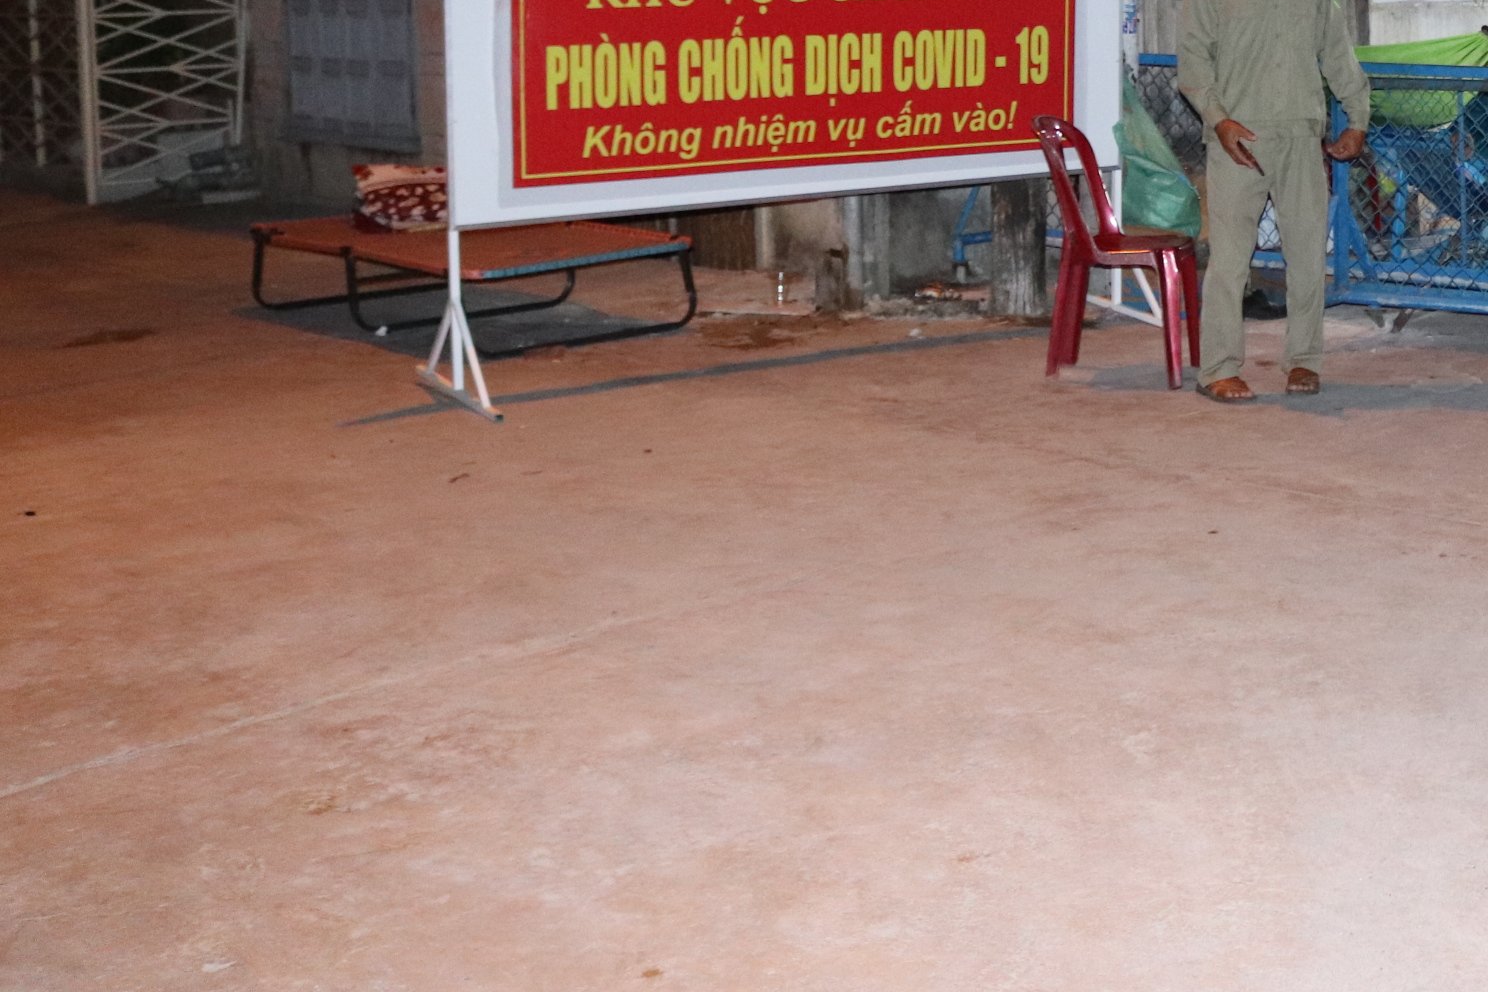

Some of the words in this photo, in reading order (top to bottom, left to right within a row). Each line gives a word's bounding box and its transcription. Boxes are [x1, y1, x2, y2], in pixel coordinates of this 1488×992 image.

[545, 32, 667, 111] PHÒNG
[677, 15, 794, 104] CHỐNG
[804, 32, 883, 106] DỊCH
[892, 28, 986, 92] COVID
[994, 55, 1007, 68] -
[1015, 25, 1050, 85] 19
[582, 122, 702, 160] Không
[712, 113, 817, 156] nhiệm
[827, 117, 866, 144] vụ
[876, 100, 942, 139] cấm
[952, 100, 1018, 133] vào!
